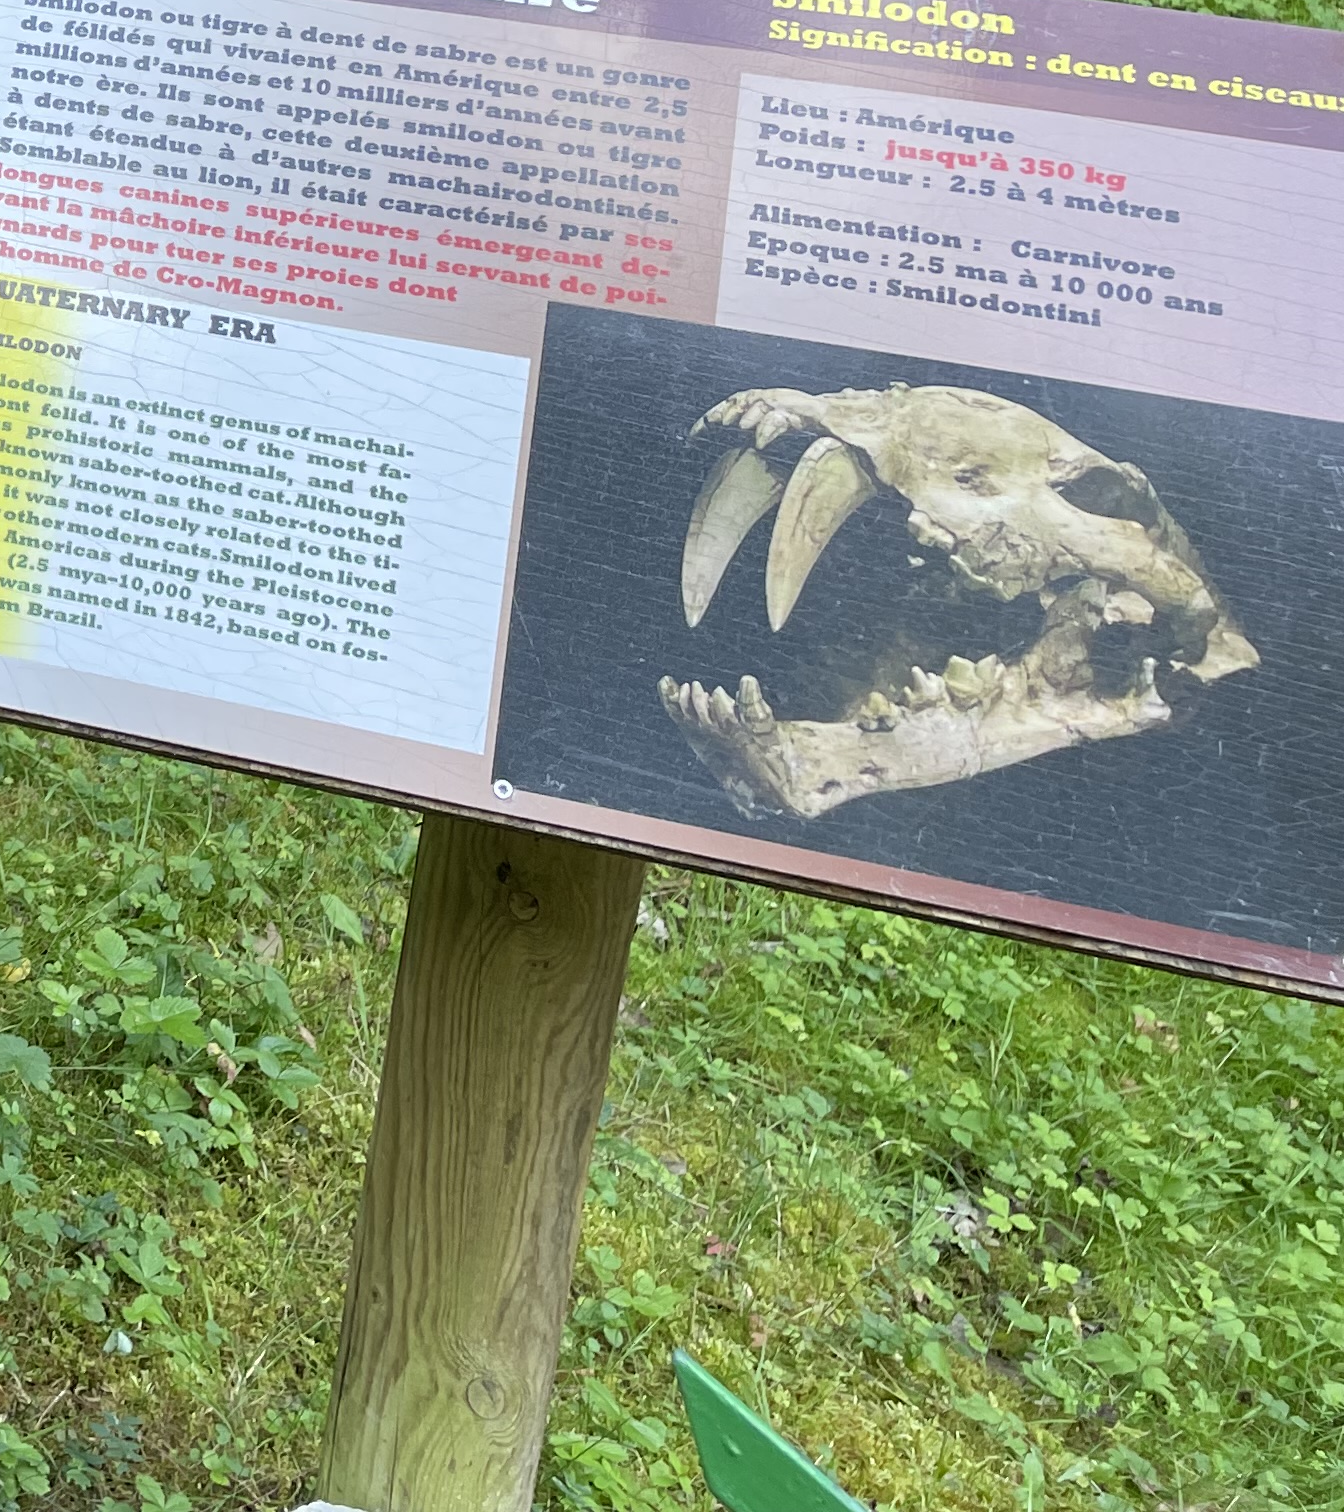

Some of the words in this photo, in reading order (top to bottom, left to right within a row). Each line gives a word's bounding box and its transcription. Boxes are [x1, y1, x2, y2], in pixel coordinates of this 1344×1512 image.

[20, 14, 54, 34] de
[62, 19, 156, 47] félidés
[166, 37, 213, 56] qui
[222, 42, 338, 72] vivaient
[347, 61, 384, 78] en
[392, 63, 540, 98] Amérique
[551, 88, 631, 110] entre
[644, 96, 688, 119] 2,5
[159, 11, 195, 28] ou
[200, 13, 269, 37] tigre
[275, 20, 293, 40] à
[299, 25, 366, 49] dent
[372, 34, 408, 54] de
[414, 43, 497, 66] sabre
[504, 55, 548, 73] est
[555, 62, 595, 79] un
[602, 68, 691, 91] genre
[768, 19, 1014, 68] Signification
[1025, 53, 1037, 71] :
[1046, 53, 1137, 84] dent
[1147, 71, 1197, 92] en
[10, 66, 85, 88] notre
[95, 73, 148, 98] ère.
[156, 82, 192, 103] Ils
[202, 93, 265, 114] sont
[276, 103, 390, 131] appelés
[402, 120, 545, 152] smilodon
[557, 142, 595, 159] ou
[608, 145, 682, 171] tigre
[14, 41, 128, 69] millions
[132, 54, 262, 87] d'années
[266, 75, 295, 92] et
[300, 76, 332, 96] 10
[335, 84, 450, 112] milliers
[455, 97, 593, 132] d'années
[599, 121, 686, 144] avant
[760, 95, 830, 121] Lieu
[838, 109, 849, 123] :
[854, 107, 1015, 145] Amérique
[2, 111, 75, 138] étant
[88, 123, 203, 157] étendue
[217, 141, 236, 162] à
[251, 148, 372, 181] d'autres
[387, 171, 679, 225] machairodontinés.
[6, 86, 24, 106] à
[33, 91, 111, 118] dents
[120, 103, 155, 124] de
[165, 112, 253, 142] sabre,
[261, 127, 333, 149] cette
[344, 135, 490, 171] deuxième
[501, 161, 680, 197] appellation
[758, 121, 846, 150] Poids
[856, 138, 866, 153] :
[884, 138, 1010, 173] jusqu'à
[1018, 156, 1076, 181] 350
[1084, 165, 1127, 193] kg
[152, 163, 189, 181] au
[197, 165, 263, 196] lion,
[270, 176, 291, 196] il
[300, 180, 368, 207] était
[378, 197, 549, 233] caractérisé
[558, 223, 615, 243] par
[624, 233, 673, 252] ses
[754, 148, 914, 187] Longueur
[922, 175, 931, 189] :
[949, 174, 996, 198] 2.5
[1006, 181, 1027, 203] à
[1035, 186, 1054, 207] 4
[1063, 193, 1181, 224] mètres
[55, 197, 84, 218] la
[89, 206, 227, 239] mâchoire
[233, 224, 380, 263] inférieure
[387, 247, 428, 271] lui
[435, 259, 551, 290] servant
[559, 275, 597, 296] de
[604, 285, 667, 306] poi-
[88, 232, 160, 255] pour
[164, 241, 226, 266] tuer
[232, 255, 278, 274] ses
[285, 263, 380, 290] proies
[387, 276, 458, 303] dont
[118, 185, 230, 213] canines
[245, 204, 420, 242] supérieures
[435, 228, 604, 270] émergeant
[620, 256, 670, 278] de-
[748, 202, 963, 250] Alimentation
[972, 238, 982, 253] :
[1010, 239, 1176, 281] Carnivore
[112, 259, 148, 280] de
[155, 265, 344, 312] Cro-Magnon.
[744, 257, 858, 291] Espèce
[868, 280, 878, 294] :
[885, 278, 1102, 328] Smilodontini
[746, 229, 870, 265] Epoque
[879, 253, 890, 268] :
[897, 251, 945, 275] 2.5
[954, 263, 1009, 285] ma
[1017, 267, 1039, 290] à
[1051, 273, 1086, 296] 10
[1096, 280, 1154, 306] 000
[1163, 295, 1224, 317] ans
[208, 314, 277, 345] ERA
[40, 403, 100, 427] felid.
[107, 414, 127, 431] It
[136, 419, 157, 437] is
[167, 428, 211, 446] one
[221, 437, 249, 453] of
[256, 441, 296, 461] the
[305, 452, 369, 475] most
[377, 462, 412, 481] fa-
[67, 385, 88, 403] is
[90, 393, 121, 409] an
[124, 399, 206, 423] extinct
[209, 413, 282, 437] genus
[285, 426, 312, 442] of
[313, 431, 415, 459] machai-
[68, 474, 147, 503] known
[153, 493, 180, 508] as
[186, 496, 226, 516] the
[231, 507, 403, 550] saber-toothed
[2, 530, 112, 563] Americas
[118, 552, 201, 584] during
[206, 568, 245, 589] the
[251, 576, 395, 618] Pleistocene
[6, 553, 50, 573] (2.5
[201, 592, 266, 616] years
[275, 608, 339, 632] ago).
[345, 617, 391, 641] The
[25, 600, 103, 631] Brazil.
